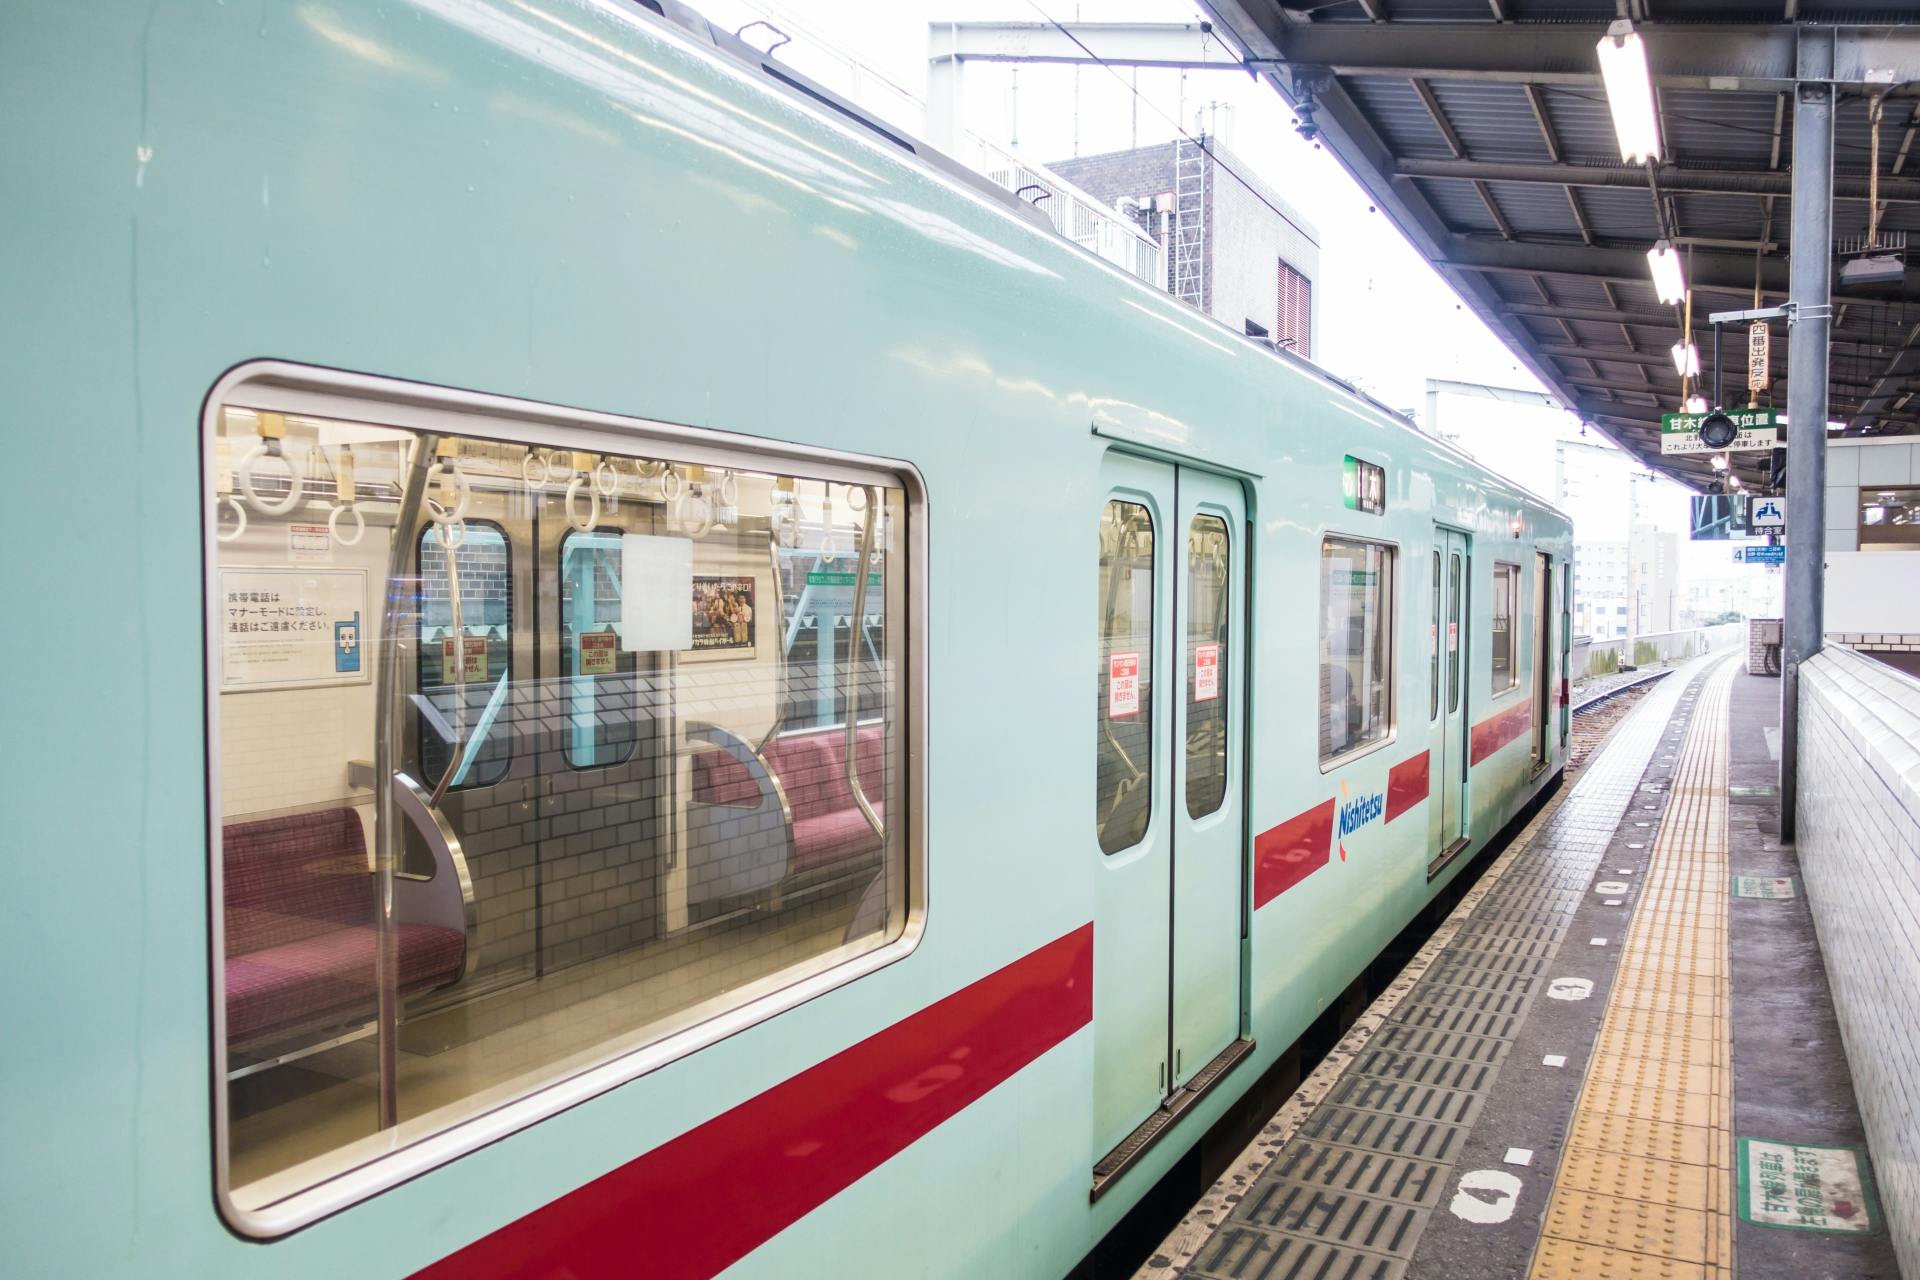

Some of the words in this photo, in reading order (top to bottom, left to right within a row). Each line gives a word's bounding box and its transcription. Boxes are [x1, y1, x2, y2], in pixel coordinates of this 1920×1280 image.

[1670, 413, 1769, 431] 甘木車位置
[1734, 550, 1743, 561] 4
[228, 592, 281, 603] 携帯電話は
[1338, 792, 1383, 839] Nishitetsu
